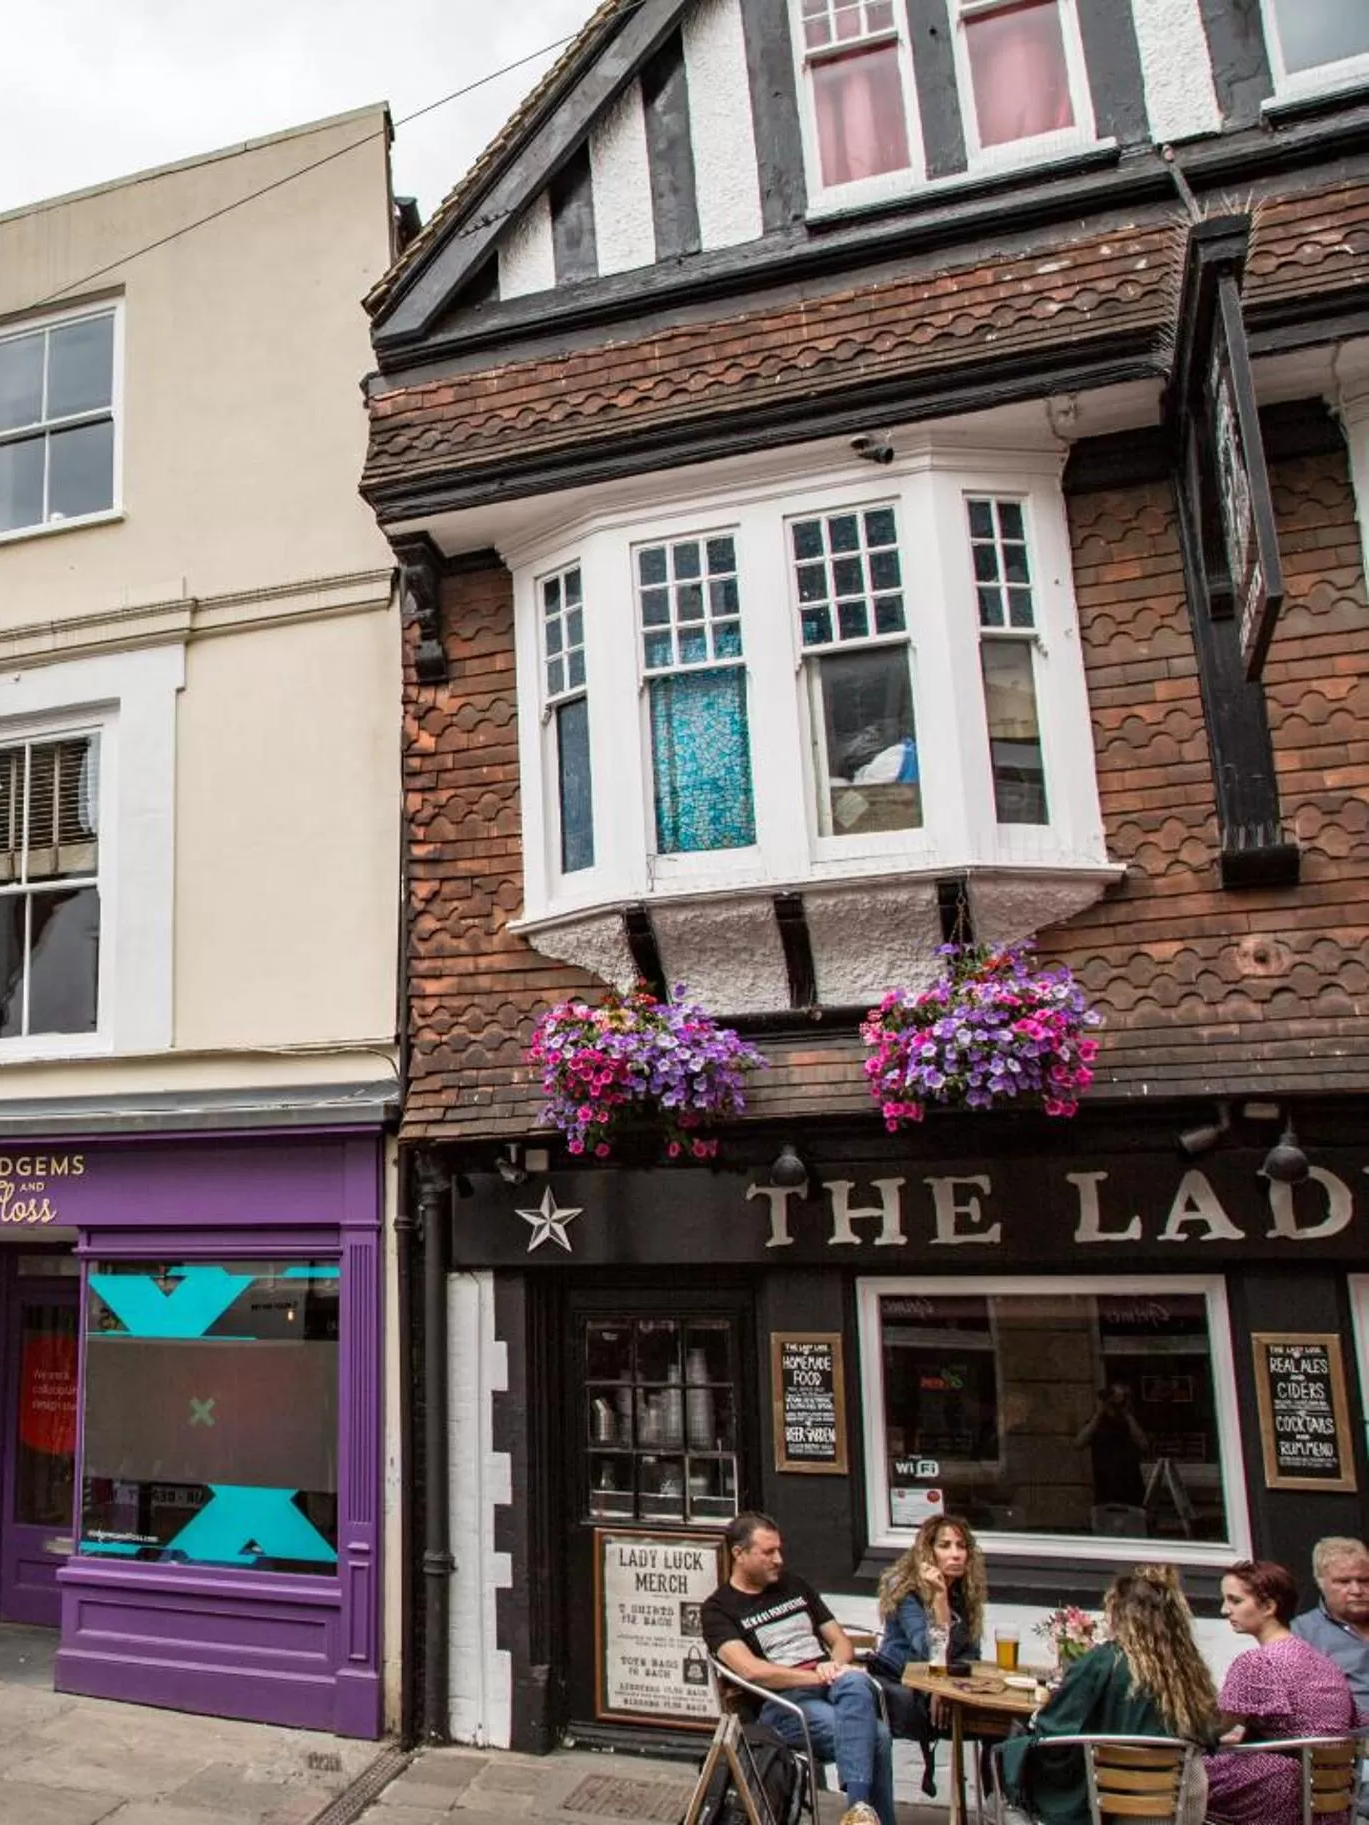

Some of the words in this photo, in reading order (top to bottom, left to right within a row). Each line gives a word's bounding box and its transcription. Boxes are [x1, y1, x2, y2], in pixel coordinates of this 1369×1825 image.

[19, 1182, 45, 1192] AND
[745, 1174, 1002, 1247] THE
[1065, 1167, 1369, 1242] LAD
[1270, 1357, 1299, 1373] REAL
[1301, 1358, 1328, 1374] ALES
[793, 1370, 822, 1386] FOOD
[1277, 1381, 1325, 1399] CIDERS
[618, 1547, 658, 1569] LADY
[664, 1550, 704, 1571] LUCK
[635, 1572, 688, 1594] MERCH
